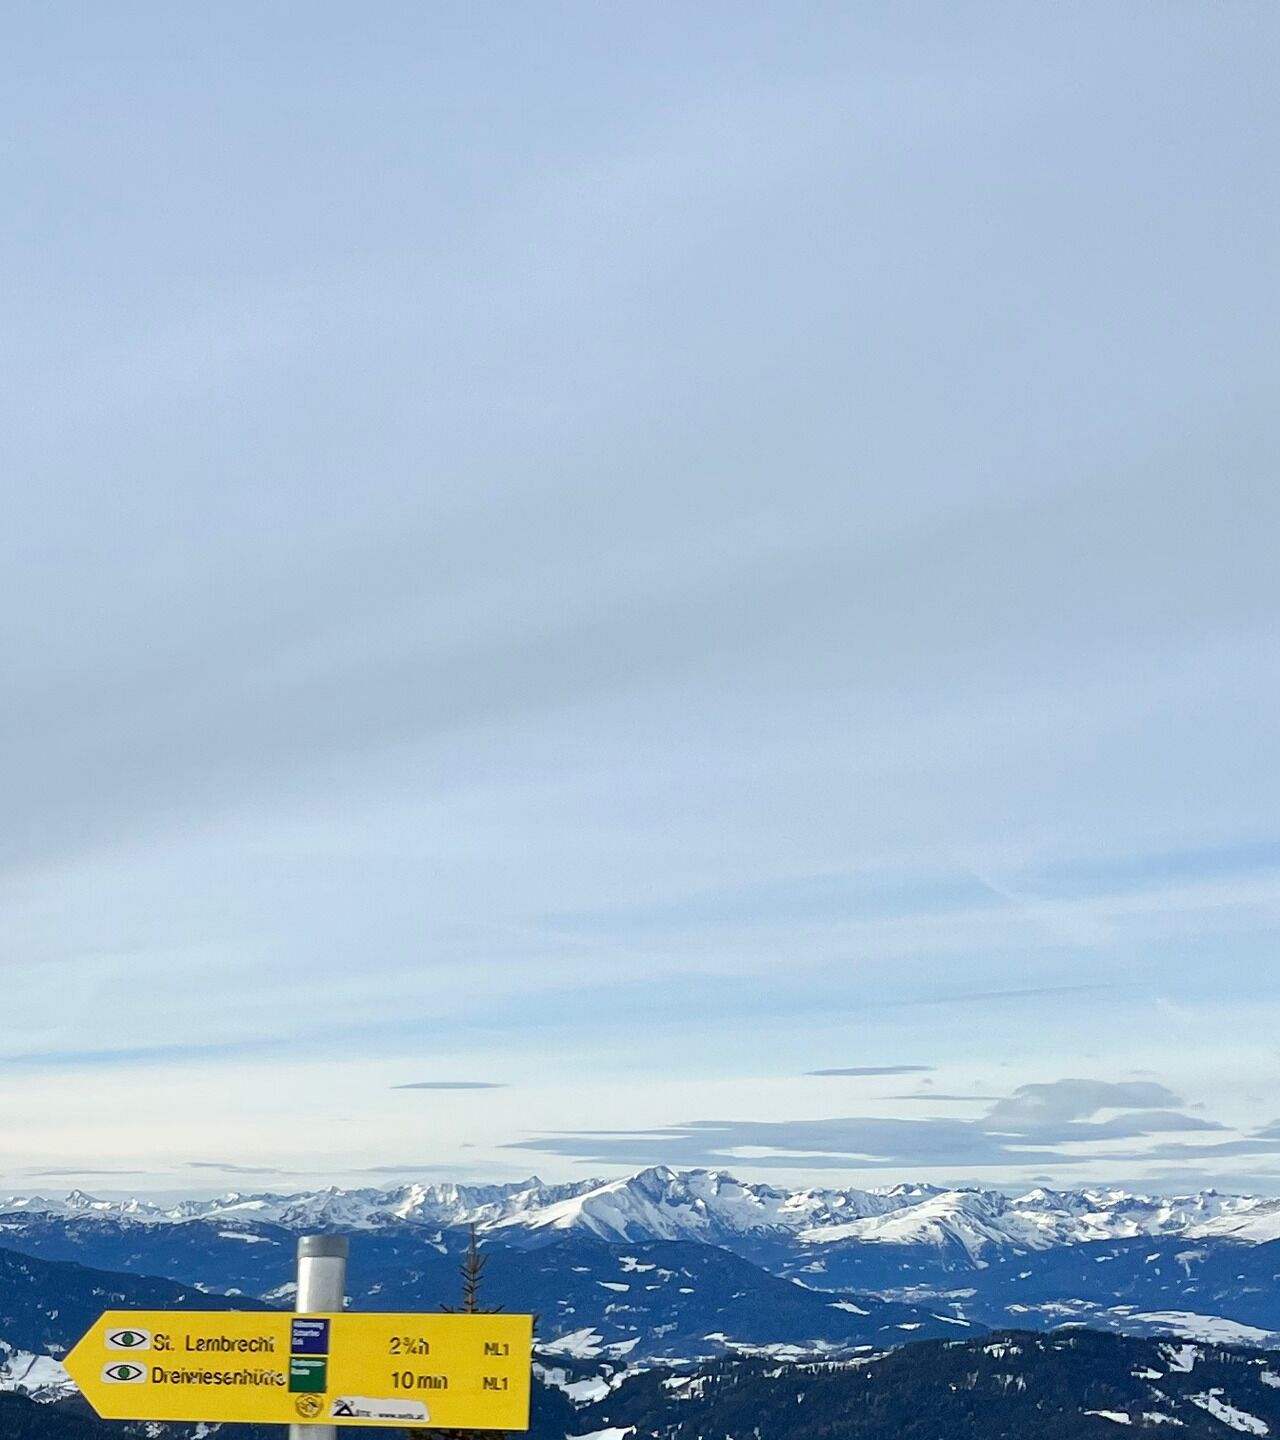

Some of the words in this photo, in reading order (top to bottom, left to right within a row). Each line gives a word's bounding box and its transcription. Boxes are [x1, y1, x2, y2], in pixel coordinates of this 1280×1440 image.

[153, 1333, 175, 1352] St.
[185, 1334, 275, 1352] Lambrecht
[484, 1342, 509, 1356] NL1
[152, 1366, 287, 1386] Dreiwiesenhütte
[391, 1371, 414, 1389] 10
[417, 1374, 448, 1389] min
[482, 1376, 508, 1390] NL1
